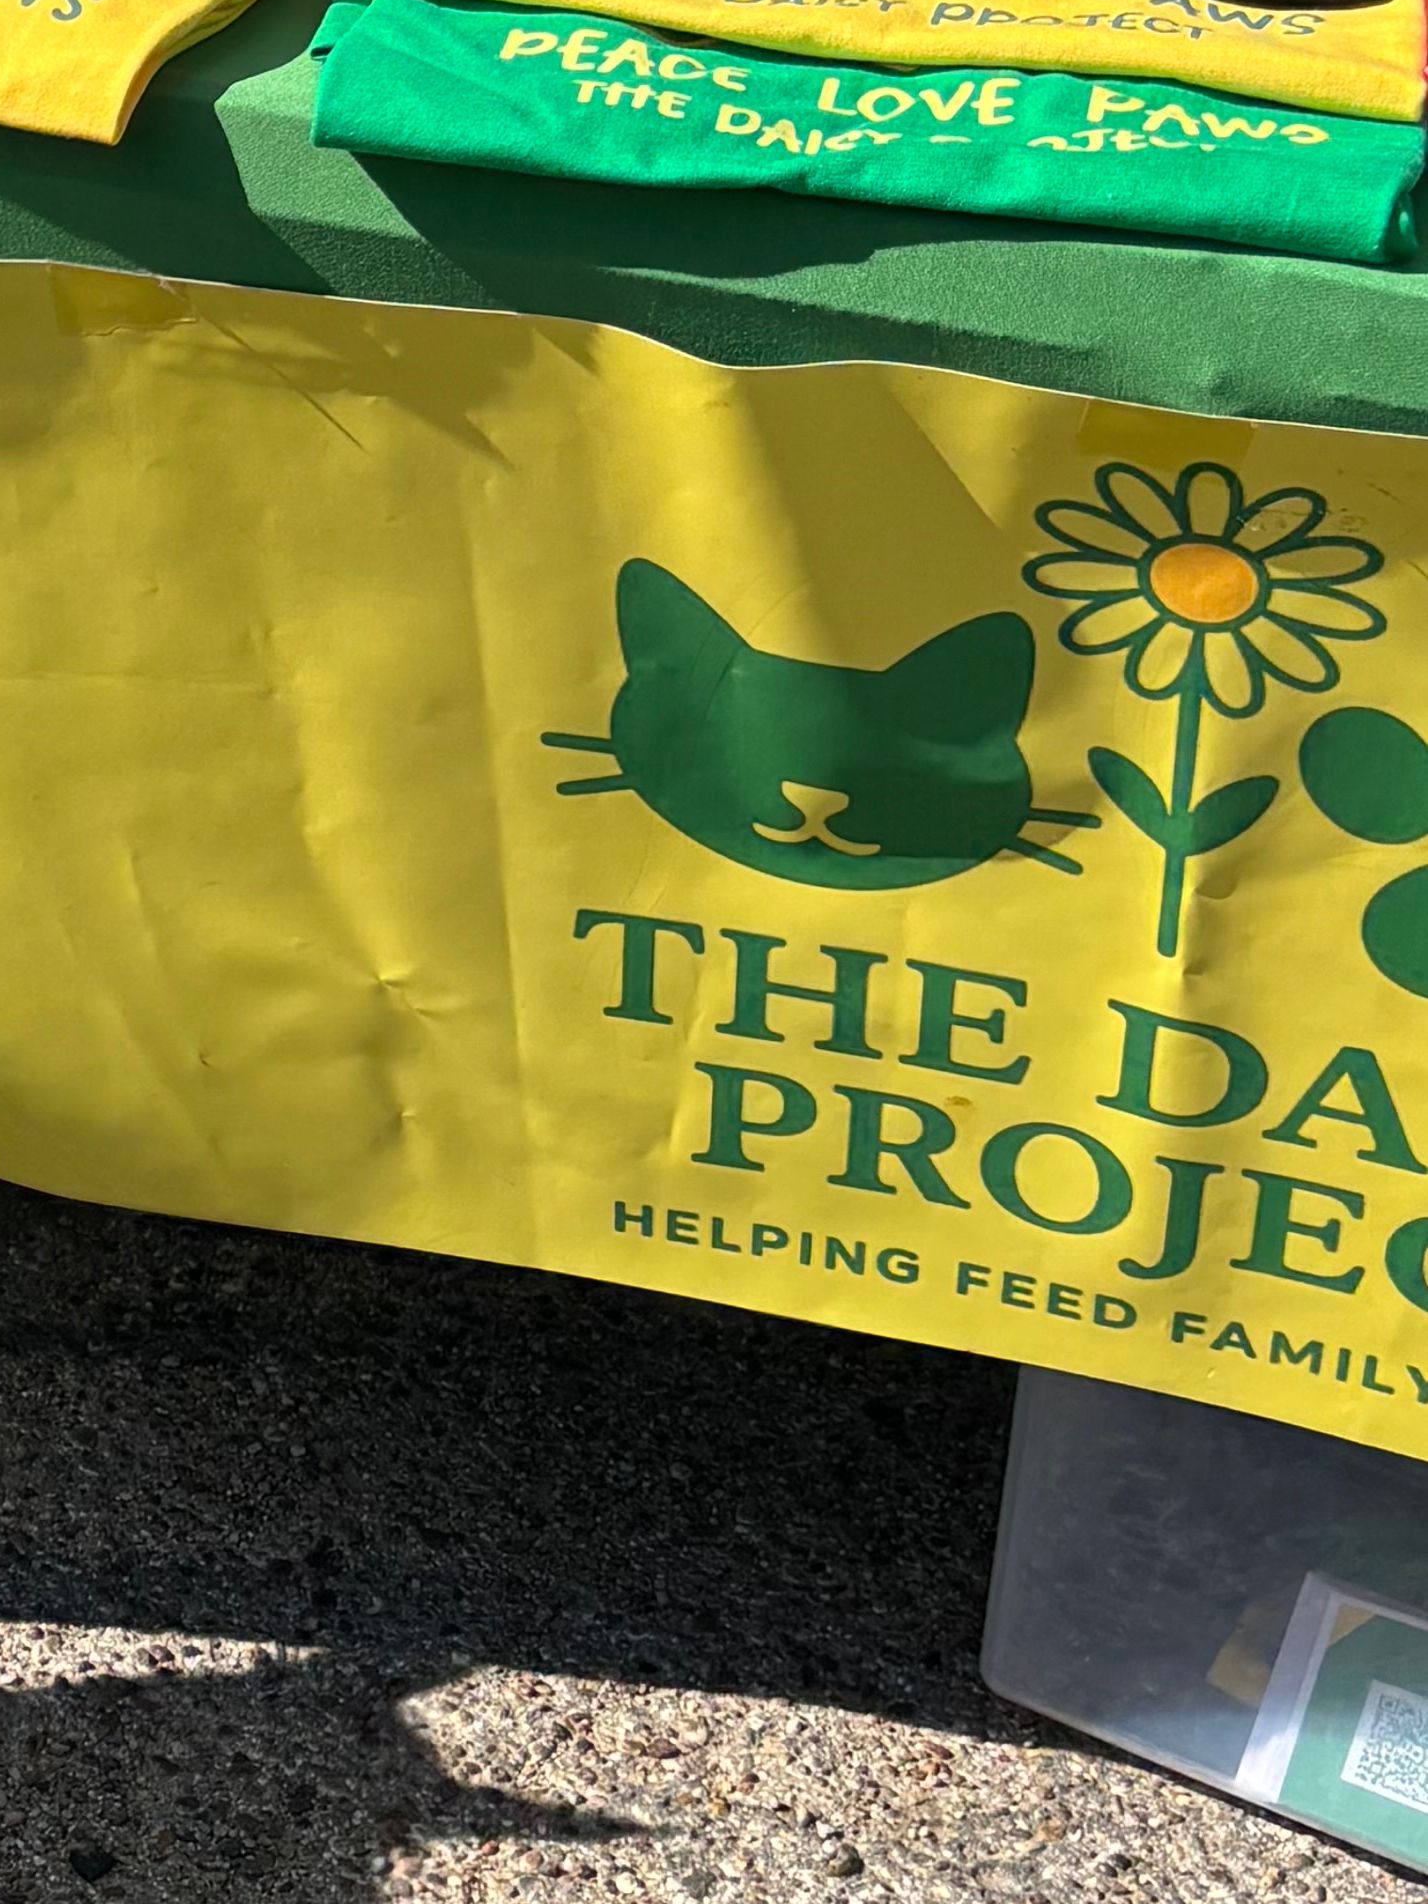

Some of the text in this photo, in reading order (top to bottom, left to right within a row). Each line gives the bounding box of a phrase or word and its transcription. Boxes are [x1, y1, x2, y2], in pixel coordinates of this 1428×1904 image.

[930, 1, 1215, 41] PROJECT
[498, 27, 1331, 145] PEACE LOVE PAWS
[571, 79, 693, 120] THE
[713, 103, 904, 156] DAISY
[572, 907, 1033, 1086] THE
[613, 1200, 1428, 1405] HELPING FEED FAMILY
